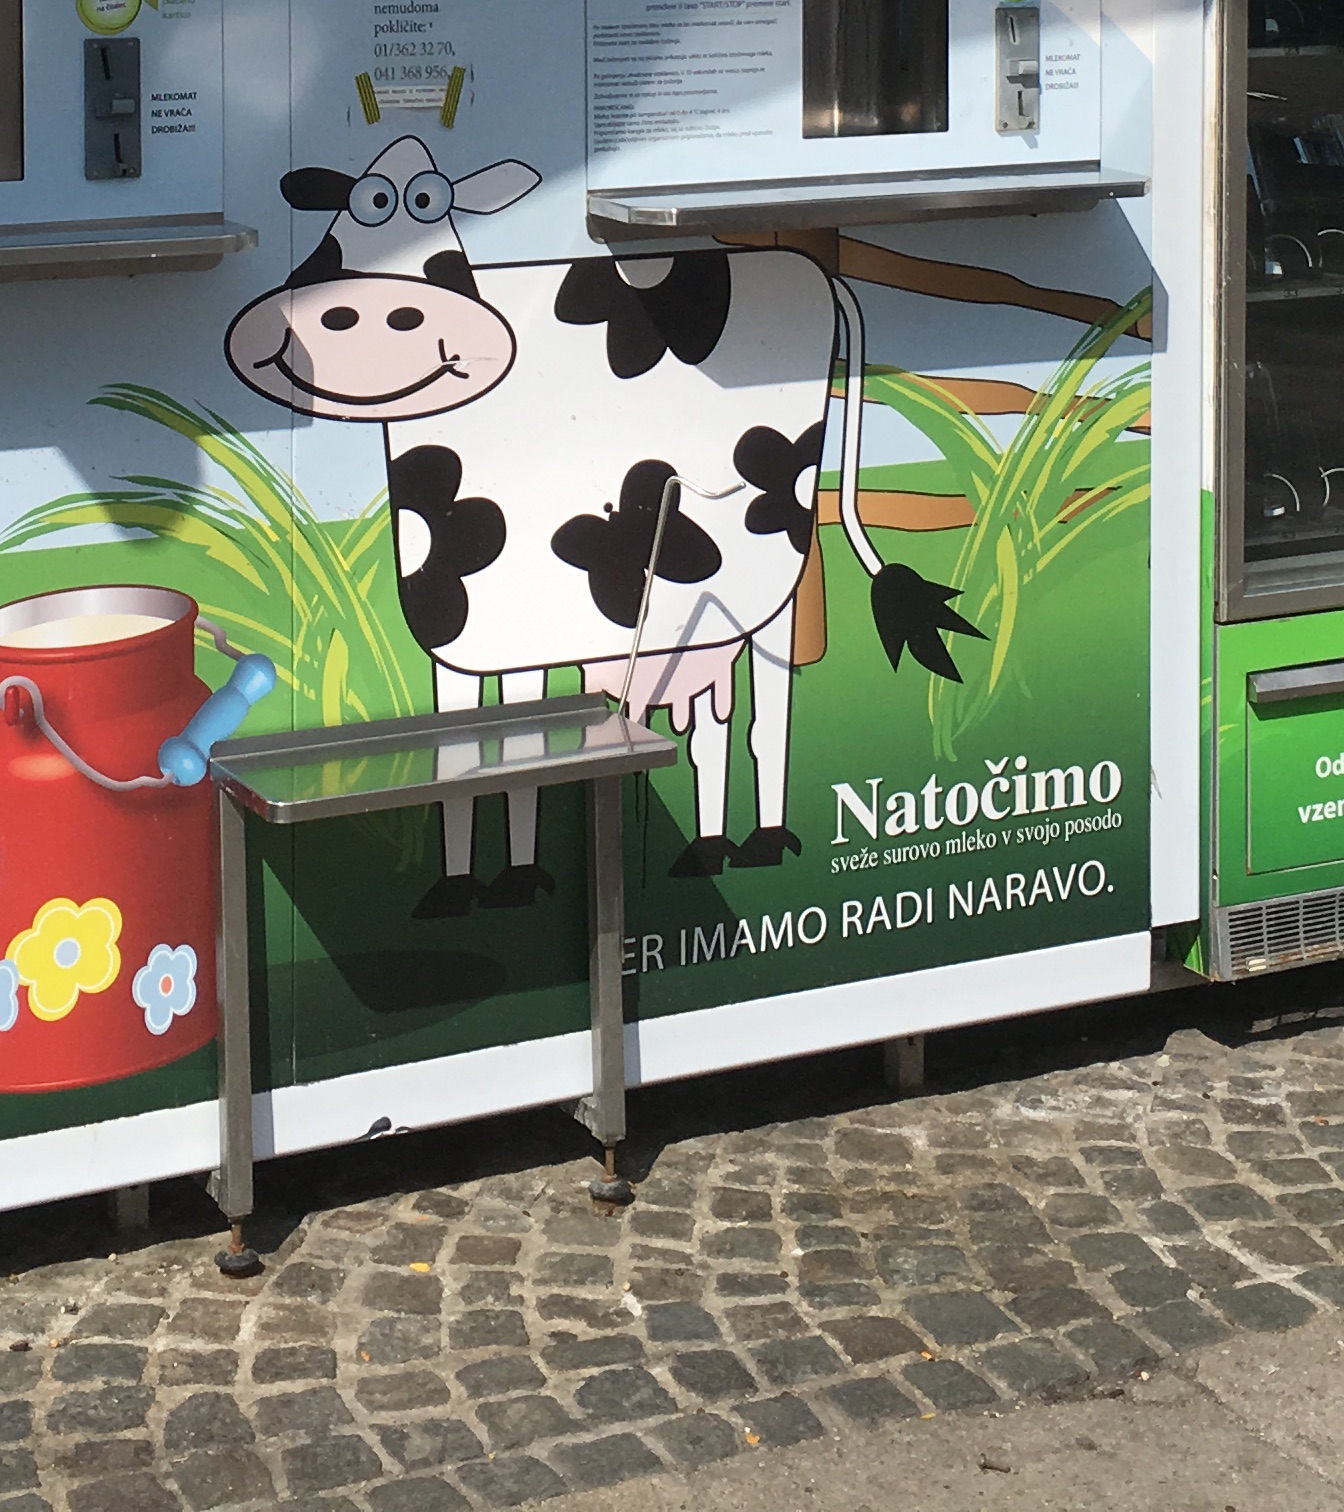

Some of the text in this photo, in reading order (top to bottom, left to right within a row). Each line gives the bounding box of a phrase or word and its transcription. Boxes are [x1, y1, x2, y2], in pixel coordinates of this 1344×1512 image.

[374, 0, 439, 15] nemudoma
[374, 20, 427, 37] pokličite:
[374, 41, 455, 58] 01/362 32 70,
[374, 66, 395, 81] 041
[400, 65, 421, 80] 368
[150, 90, 197, 102] MLEKOMAT
[830, 754, 1124, 847] Natočimo
[830, 809, 1123, 875] sveže surovo mleko v svojo posodo
[621, 859, 1116, 977] ER IMAMO RADI NARAVO.
